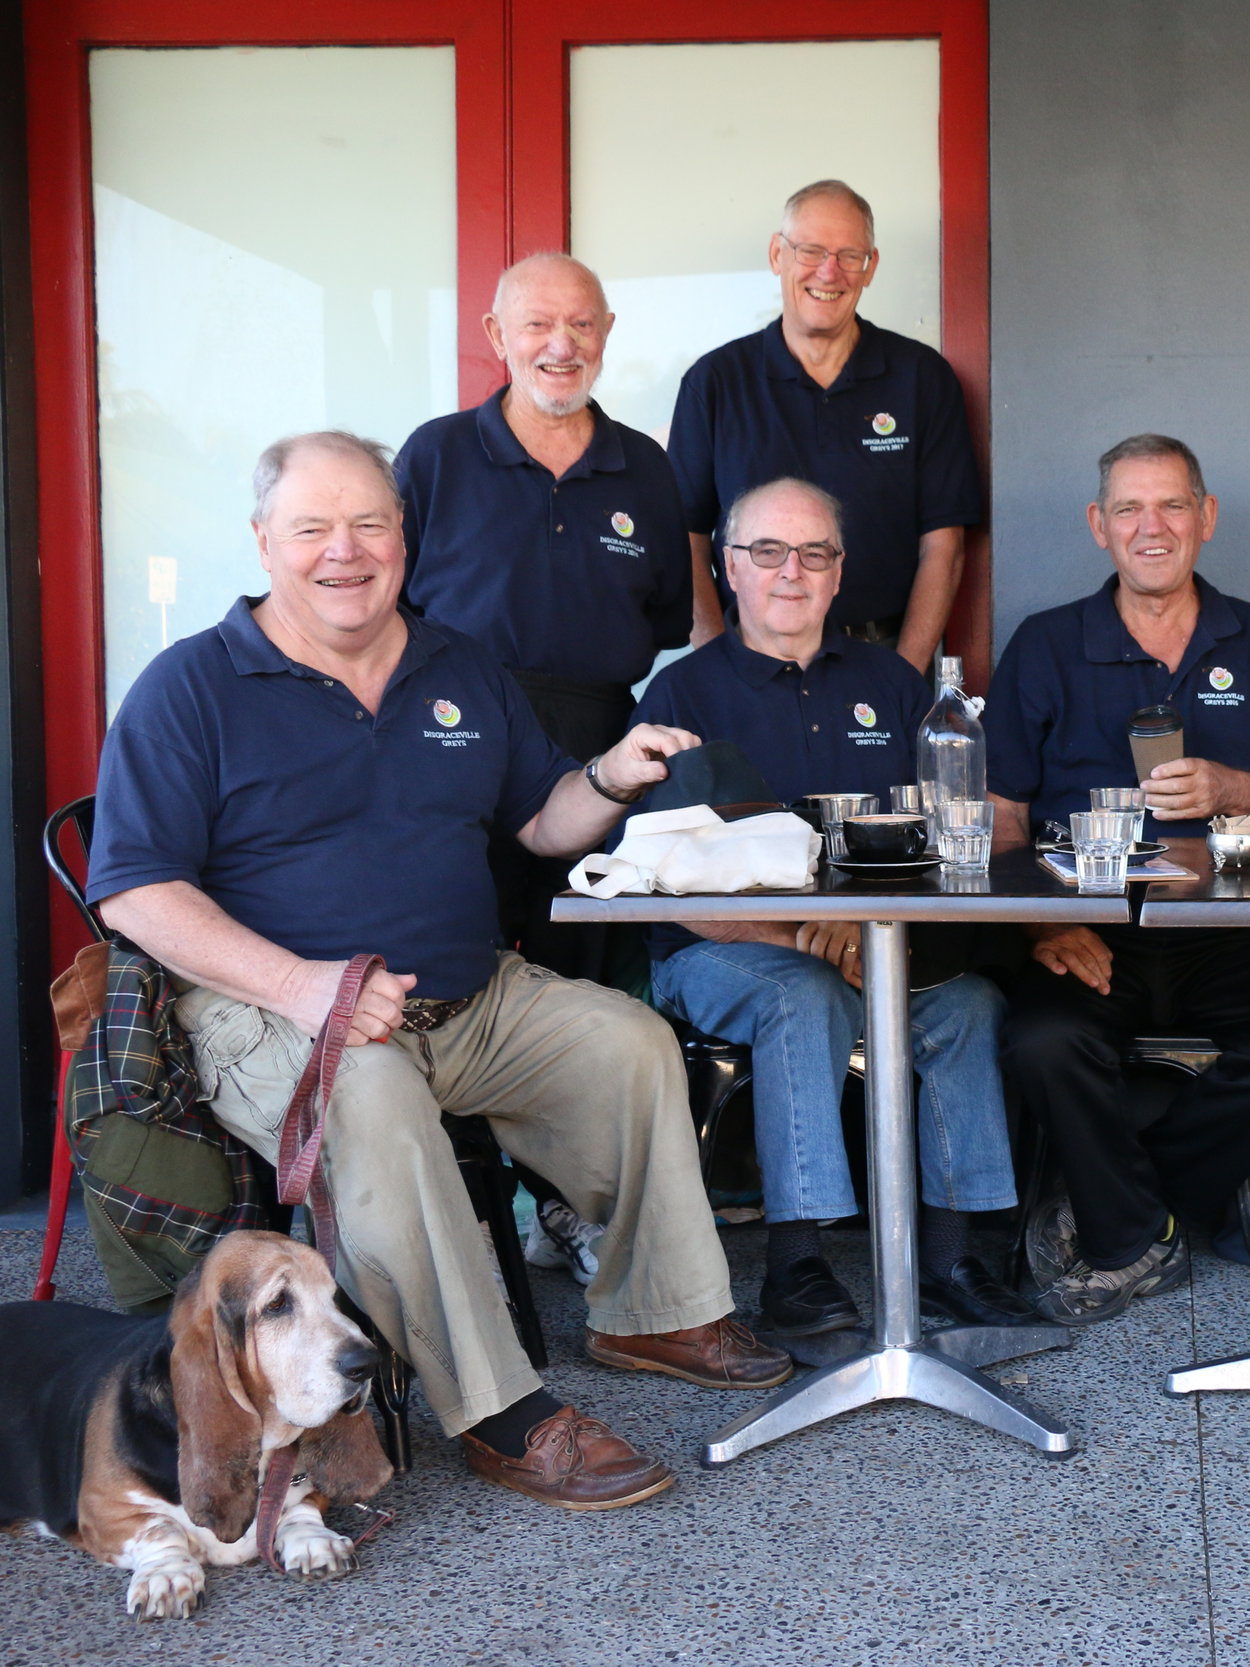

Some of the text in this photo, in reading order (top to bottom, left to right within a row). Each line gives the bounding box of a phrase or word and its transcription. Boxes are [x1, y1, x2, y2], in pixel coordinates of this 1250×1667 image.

[862, 436, 909, 446] DISGRACEVILLE
[599, 536, 646, 554] DISGRACEVILLE
[607, 545, 627, 555] GREYS
[1197, 692, 1245, 701] DISGRACEVILLE
[424, 730, 480, 739] DISGRACEVILLE
[847, 731, 892, 739] DISGRACEVILLE
